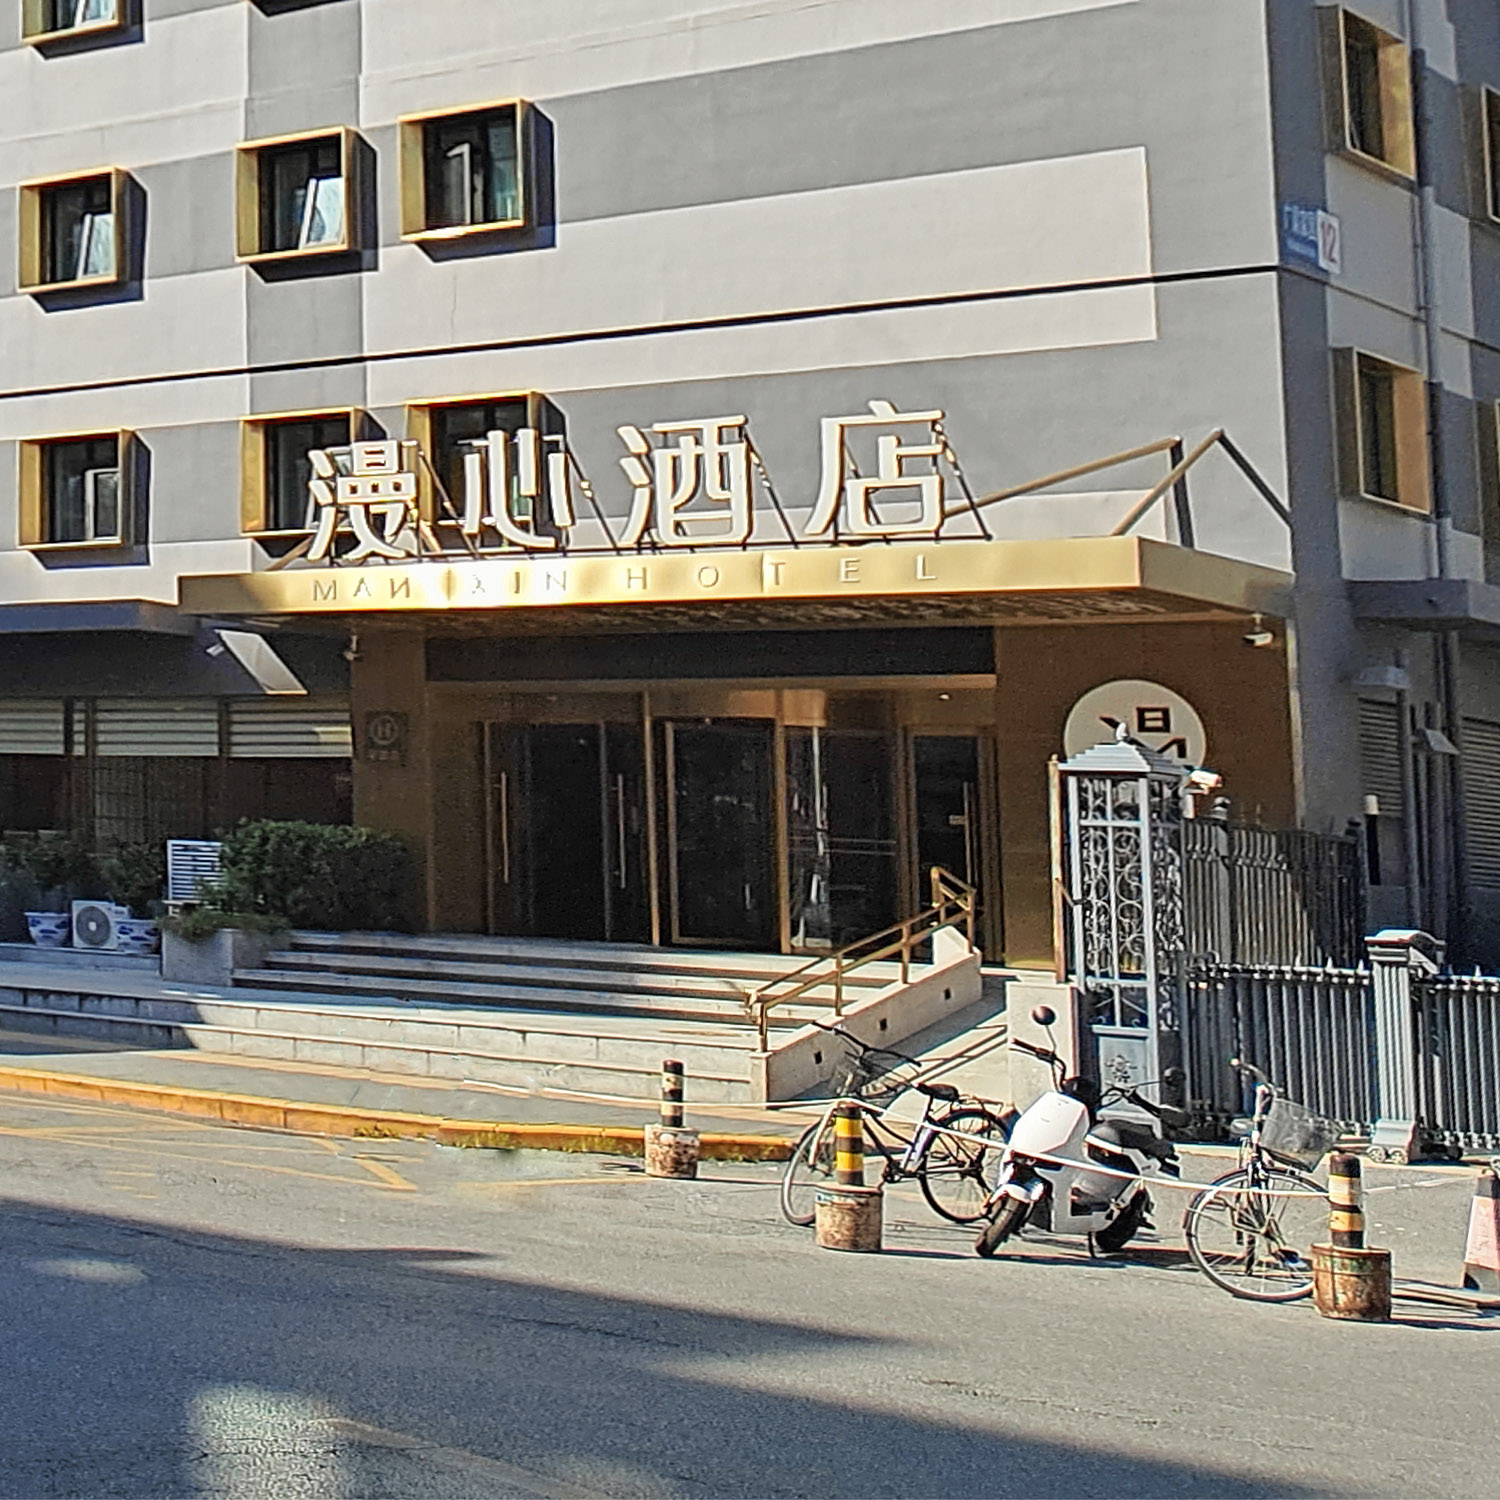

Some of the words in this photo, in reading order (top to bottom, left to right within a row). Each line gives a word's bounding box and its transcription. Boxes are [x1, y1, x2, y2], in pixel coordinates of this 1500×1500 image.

[1320, 219, 1338, 265] 12
[305, 400, 947, 562] 漫心酒店
[625, 554, 937, 591] HOTEL
